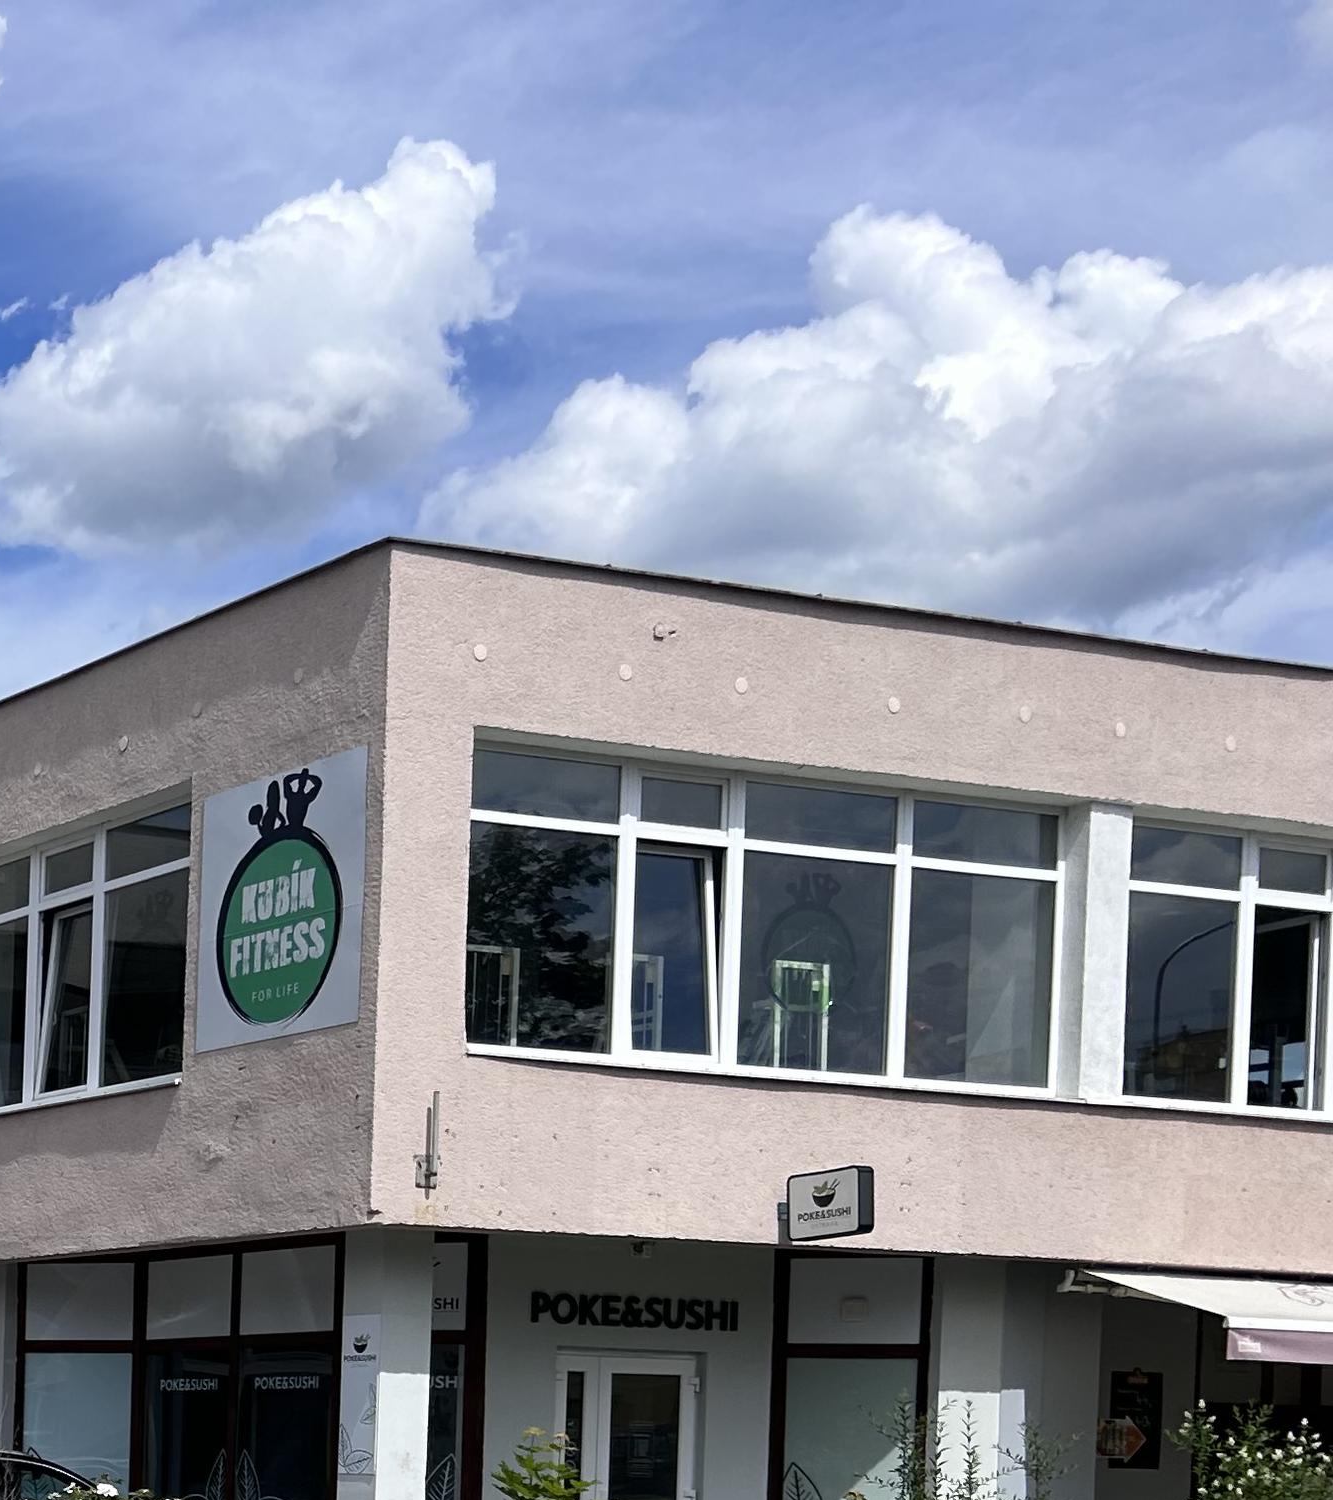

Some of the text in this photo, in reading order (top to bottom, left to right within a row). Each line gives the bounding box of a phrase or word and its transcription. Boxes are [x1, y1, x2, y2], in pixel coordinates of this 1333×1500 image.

[241, 859, 316, 924] KUBÍK
[230, 917, 325, 978] FITNESS
[251, 982, 300, 1003] FOR LIFE
[797, 1206, 851, 1222] POKE&SUSHI
[530, 1290, 739, 1332] POKE&SUSHI
[160, 1377, 219, 1391] POKE&SUSHI
[254, 1375, 320, 1390] POKE&SUSHI
